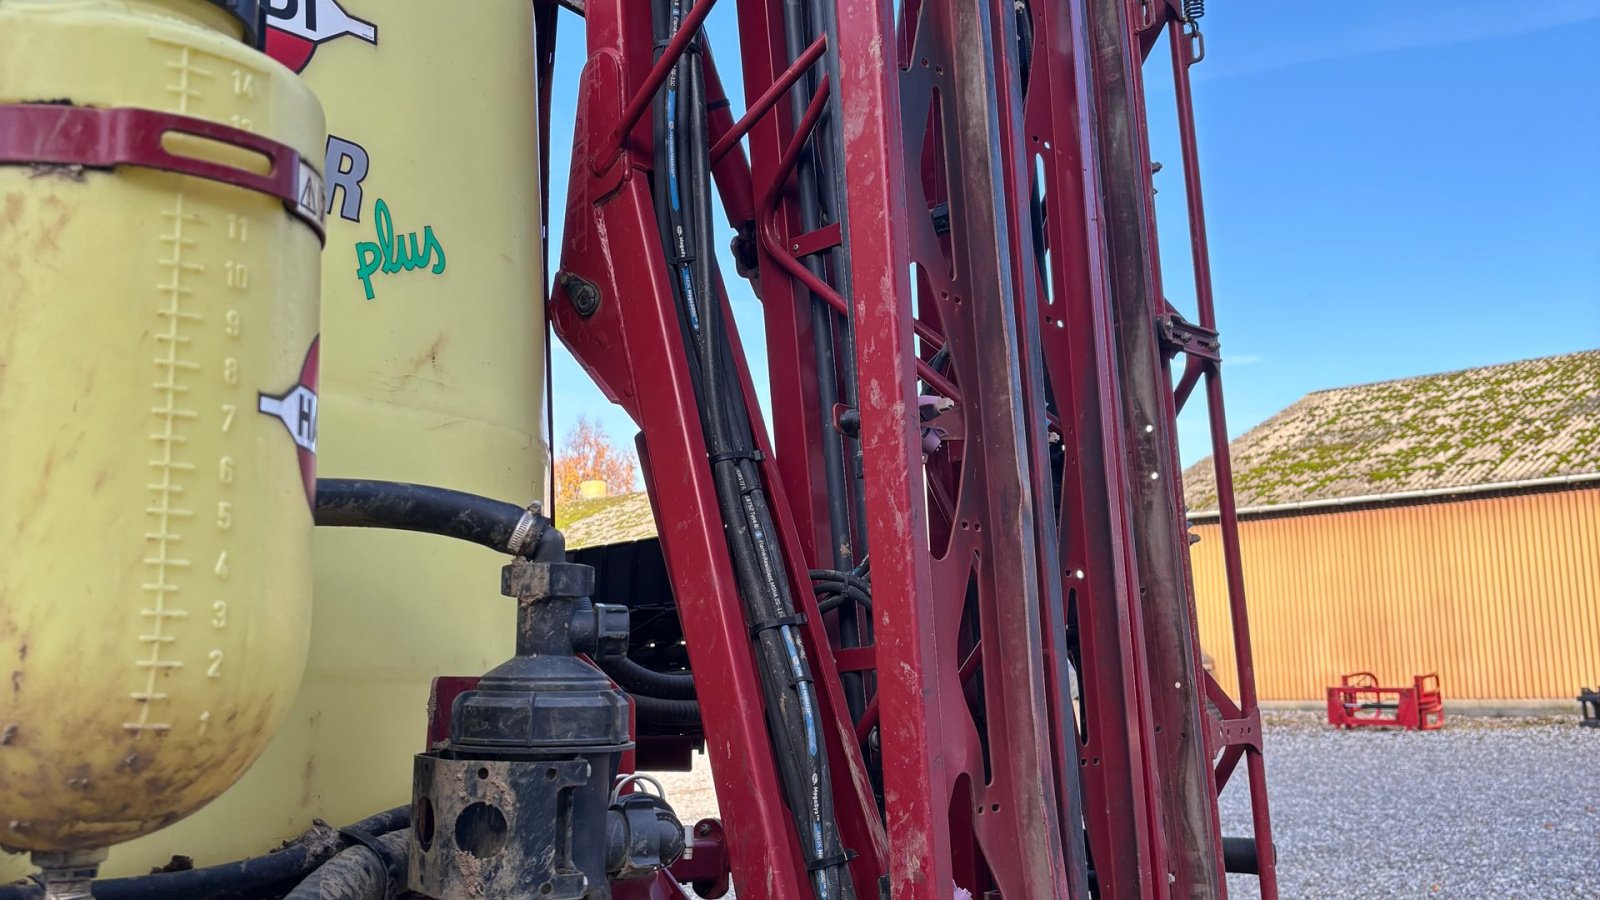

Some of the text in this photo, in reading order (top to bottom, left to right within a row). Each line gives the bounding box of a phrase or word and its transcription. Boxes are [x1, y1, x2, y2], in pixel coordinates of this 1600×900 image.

[325, 134, 370, 223] R
[227, 214, 248, 241] 11
[355, 198, 446, 300] plus
[224, 260, 248, 290] 10
[226, 311, 240, 336] 9
[223, 358, 238, 384] 8
[221, 405, 236, 432] 7
[218, 456, 235, 484] 6
[216, 502, 231, 530] 5
[214, 551, 229, 579] 4
[211, 601, 227, 628] 3
[207, 650, 224, 677] 2
[199, 711, 211, 736] 1
